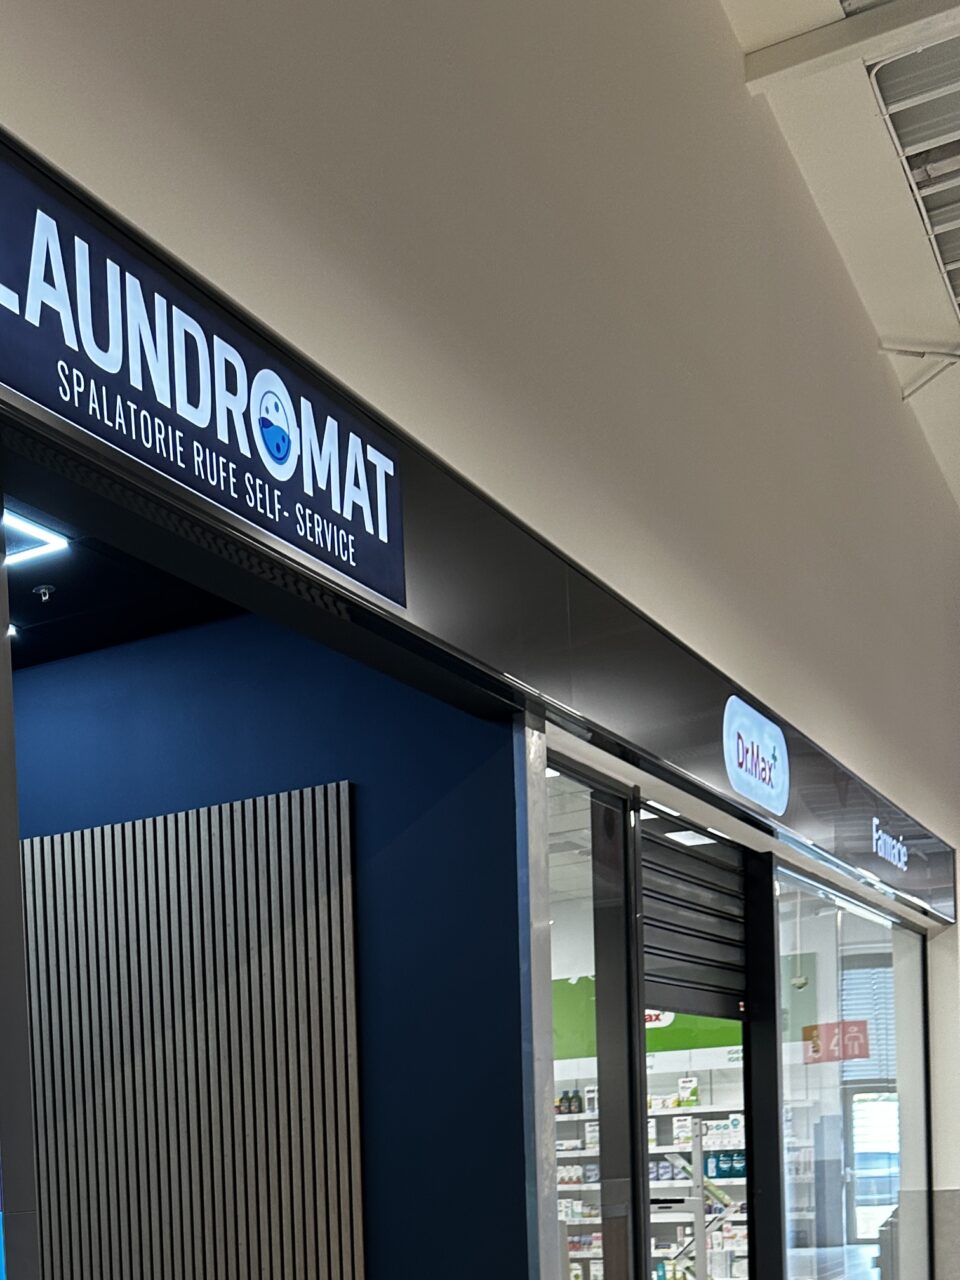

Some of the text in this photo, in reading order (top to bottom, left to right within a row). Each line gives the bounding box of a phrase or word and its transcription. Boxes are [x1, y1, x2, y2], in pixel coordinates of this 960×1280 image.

[57, 360, 186, 469] SPALATORIE
[193, 441, 238, 499] RUFE
[295, 503, 357, 567] SERVICE
